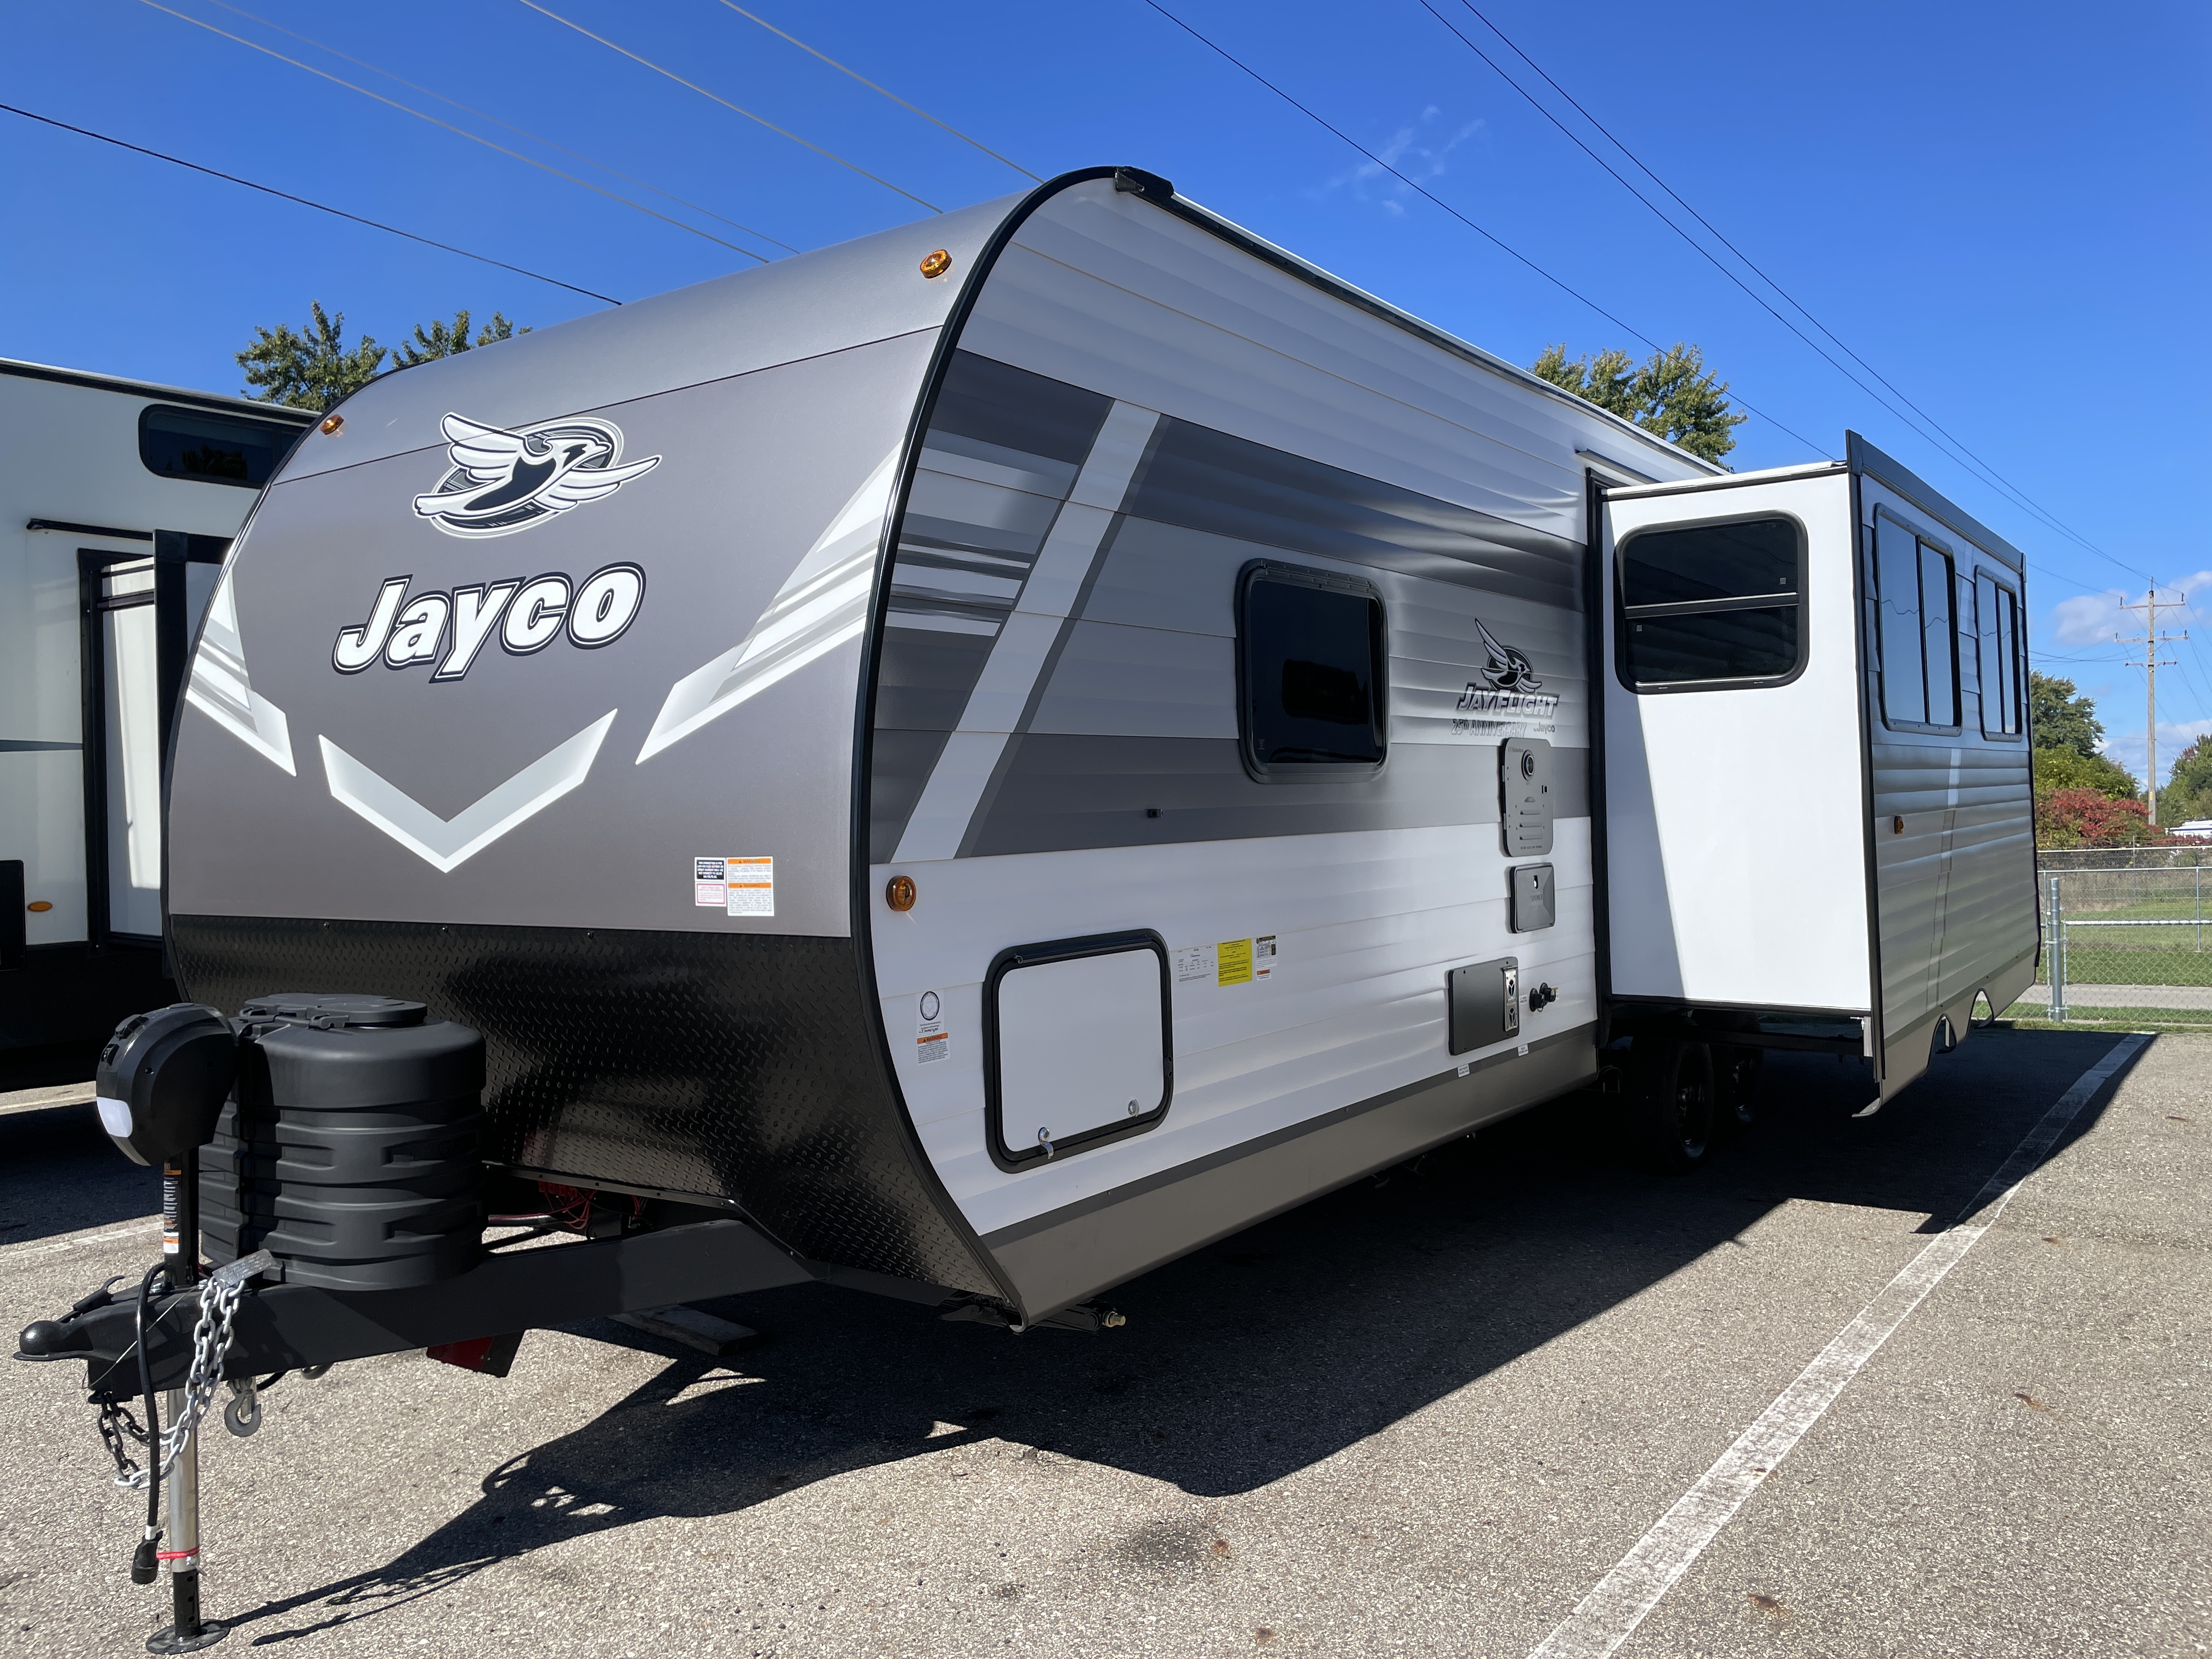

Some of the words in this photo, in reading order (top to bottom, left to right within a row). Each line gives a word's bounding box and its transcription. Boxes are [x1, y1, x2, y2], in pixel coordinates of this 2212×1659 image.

[332, 561, 646, 684] Jayco
[1451, 718, 1469, 735] 25th
[1469, 719, 1527, 737] ANNIVERSARY
[1537, 722, 1555, 735] Jayco
